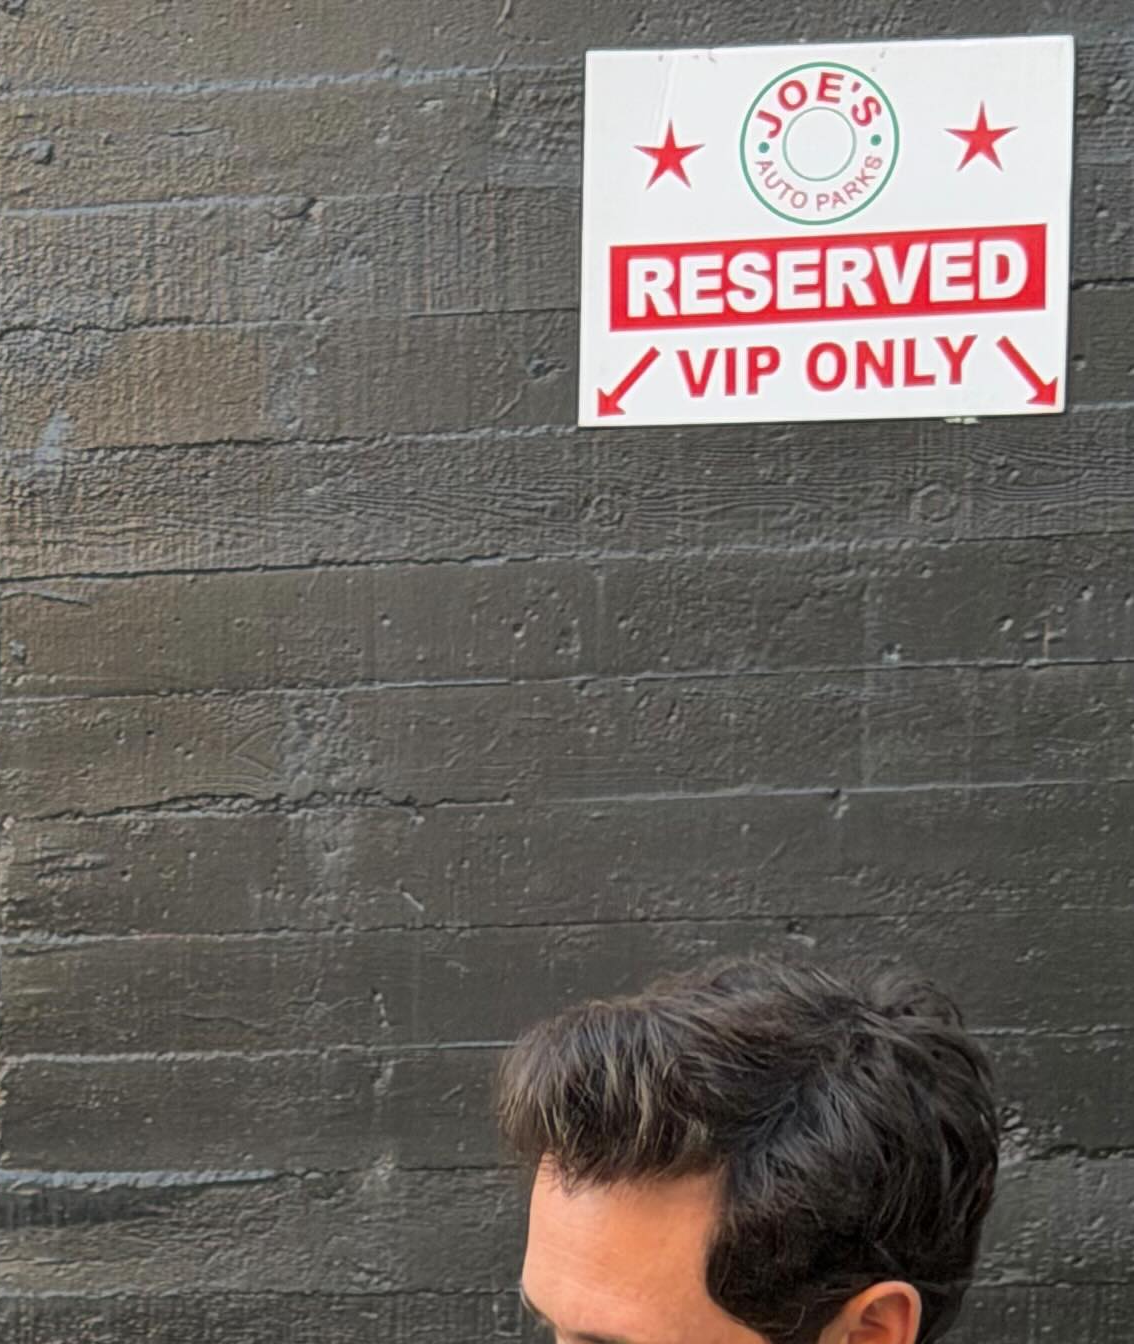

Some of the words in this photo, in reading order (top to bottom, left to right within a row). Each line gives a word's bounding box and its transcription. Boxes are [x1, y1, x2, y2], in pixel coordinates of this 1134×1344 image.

[756, 71, 884, 140] JOE'S
[754, 157, 809, 210] AUTO
[815, 155, 884, 212] PARKS
[626, 238, 1029, 318] RESERVED
[676, 344, 781, 398] VIP
[806, 334, 978, 392] ONLY
